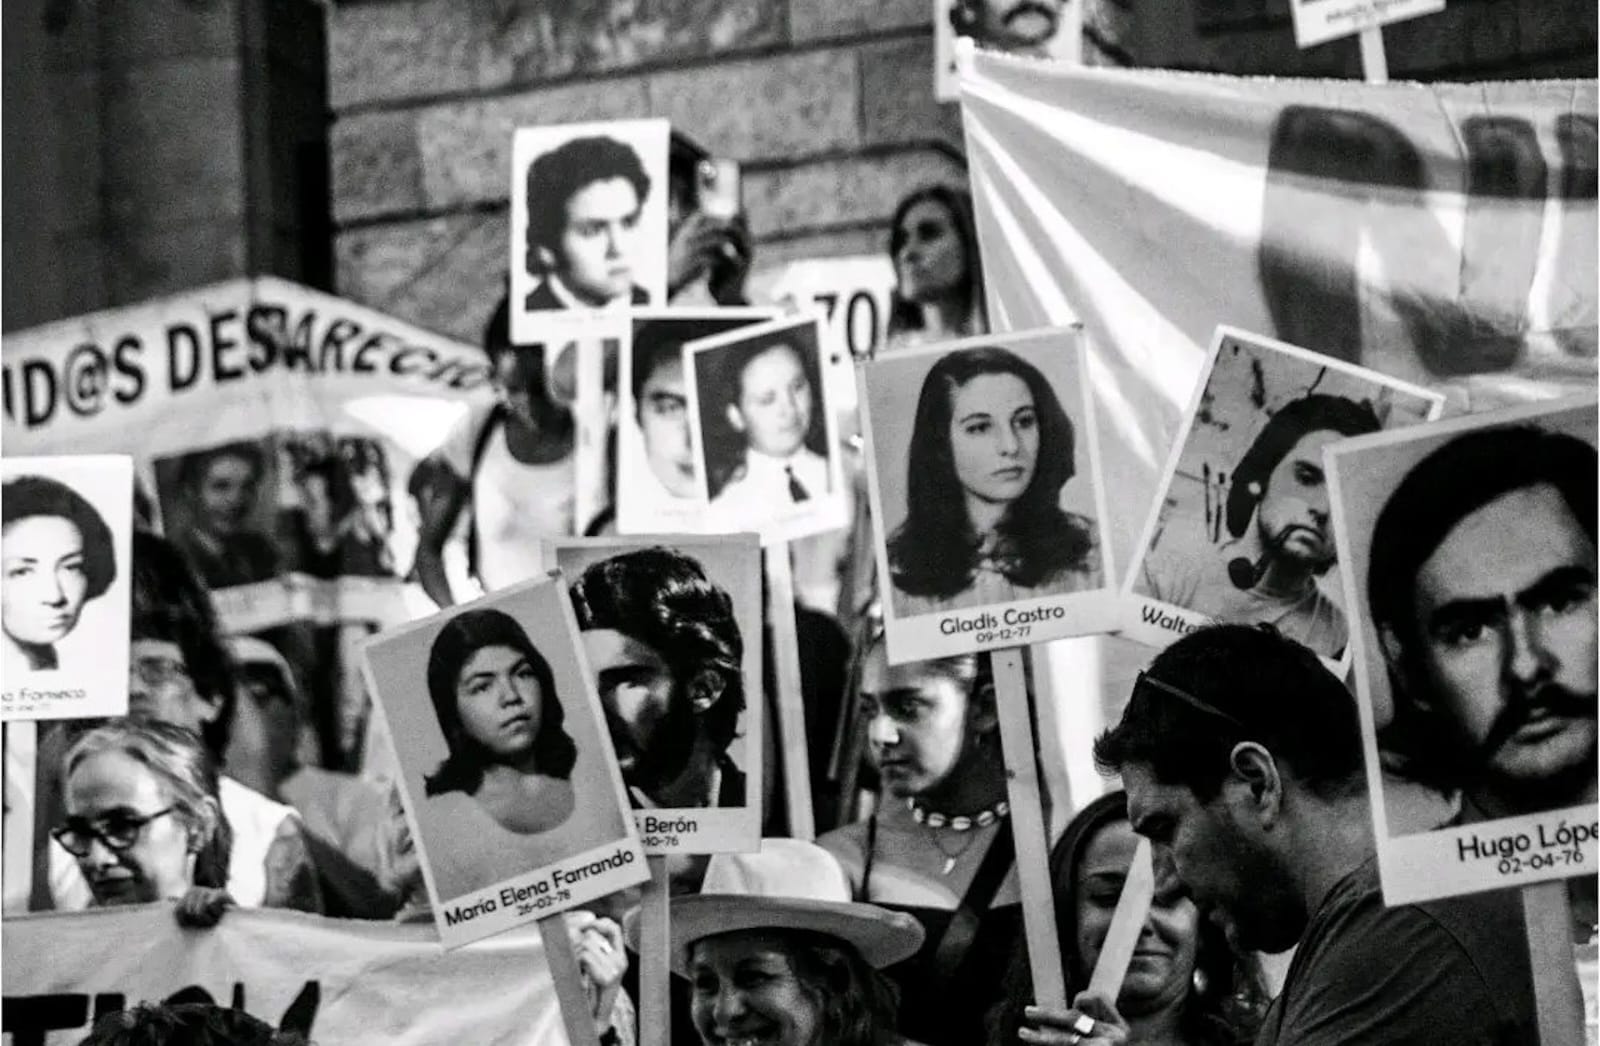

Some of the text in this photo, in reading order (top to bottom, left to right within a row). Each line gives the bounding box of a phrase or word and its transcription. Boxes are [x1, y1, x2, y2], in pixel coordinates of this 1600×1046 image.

[2, 334, 148, 429] ID@S
[939, 604, 1065, 636] Gladis Castro
[1142, 604, 1199, 634] Walte
[975, 625, 1032, 644] 09-12-77
[645, 816, 698, 834] Berón
[640, 835, 679, 847] -10-76
[1456, 819, 1599, 863] Hugo Lópe
[1497, 849, 1584, 875] 02-04-76
[444, 849, 634, 927] María Elena Farrando
